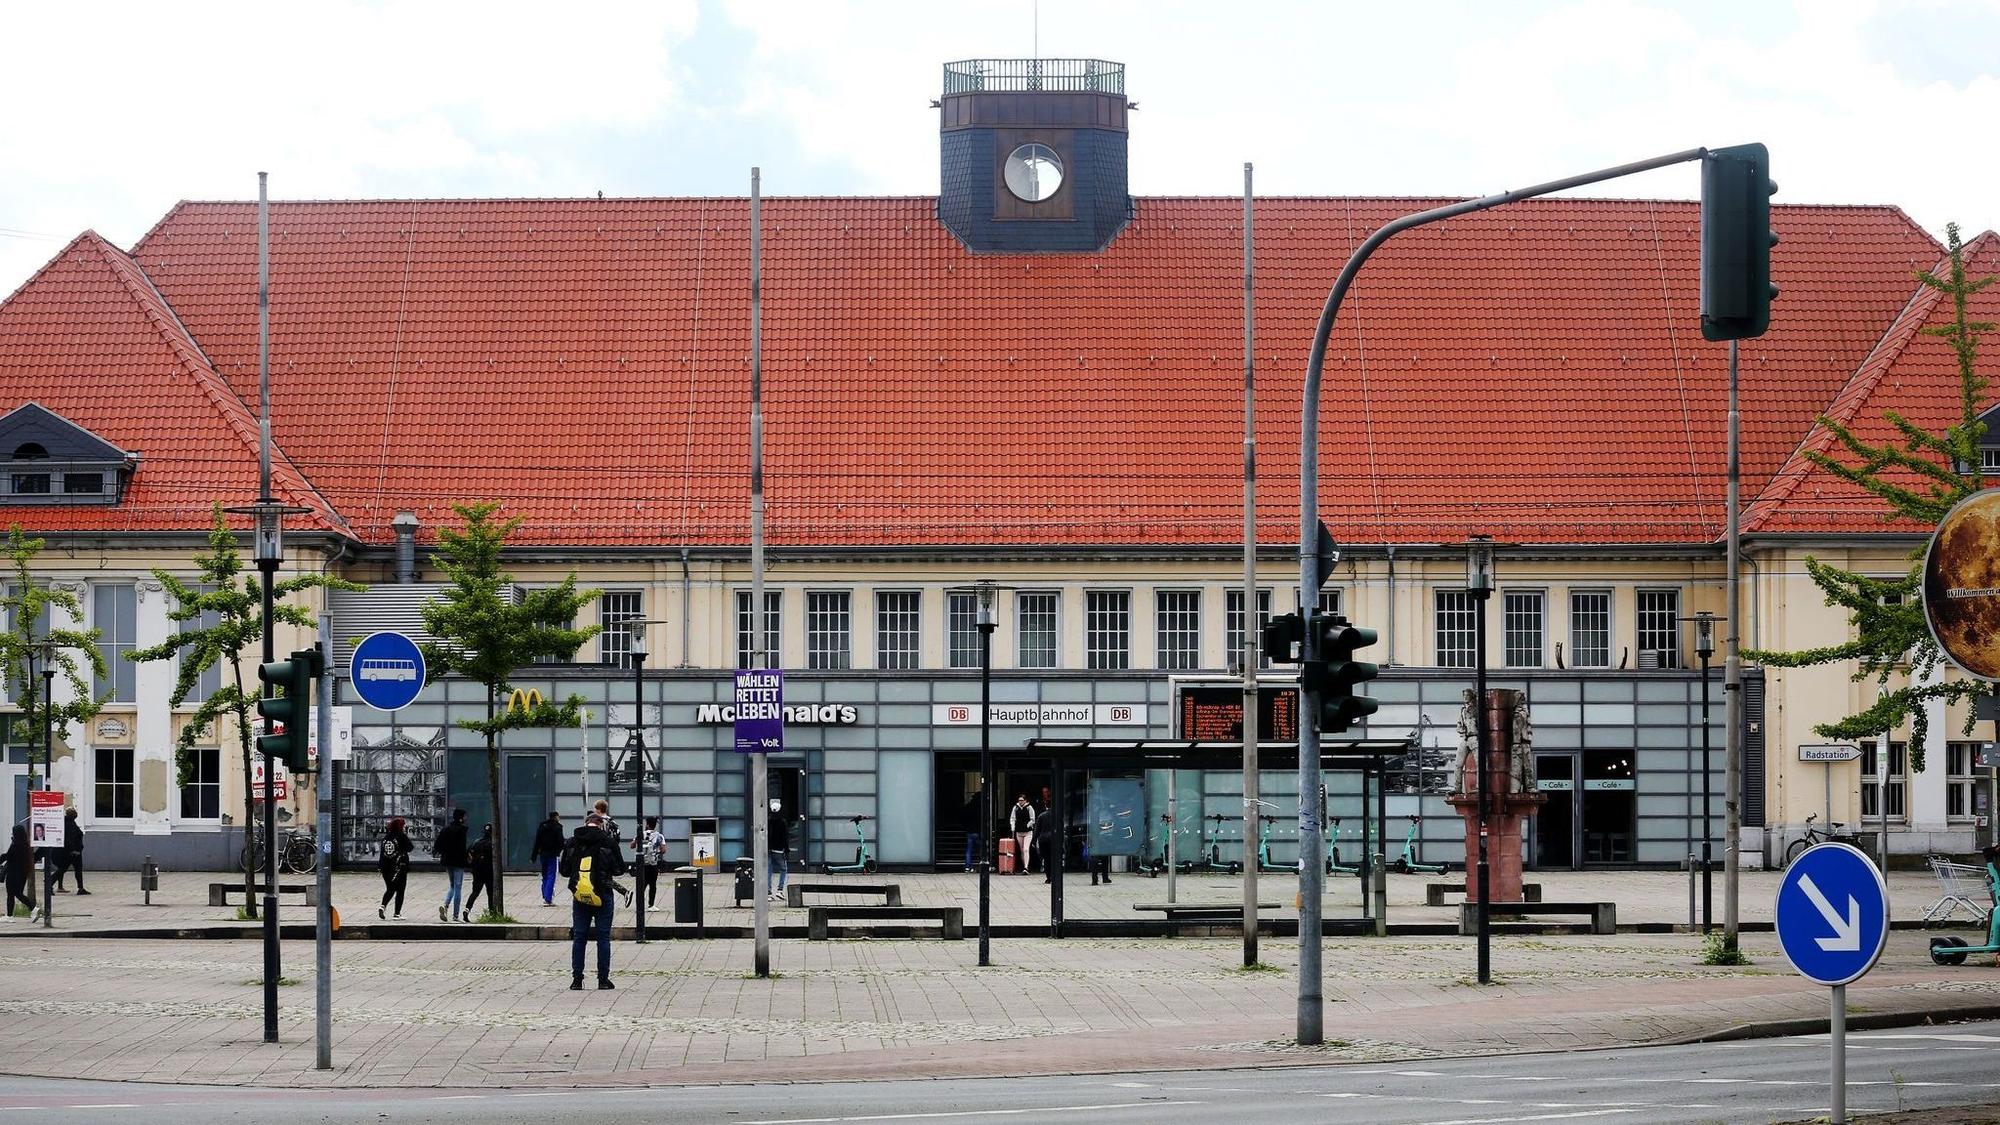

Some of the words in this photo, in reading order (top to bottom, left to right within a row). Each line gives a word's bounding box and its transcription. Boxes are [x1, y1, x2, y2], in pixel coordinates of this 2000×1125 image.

[736, 673, 779, 687] WÄHLEN
[736, 688, 779, 702] RETTET
[698, 704, 856, 723] Mcnald's
[736, 703, 779, 719] LEBEN
[951, 709, 966, 720] DB
[989, 708, 1089, 723] Hauptbahnhof
[1113, 709, 1129, 720] DB
[761, 738, 779, 747] Volt
